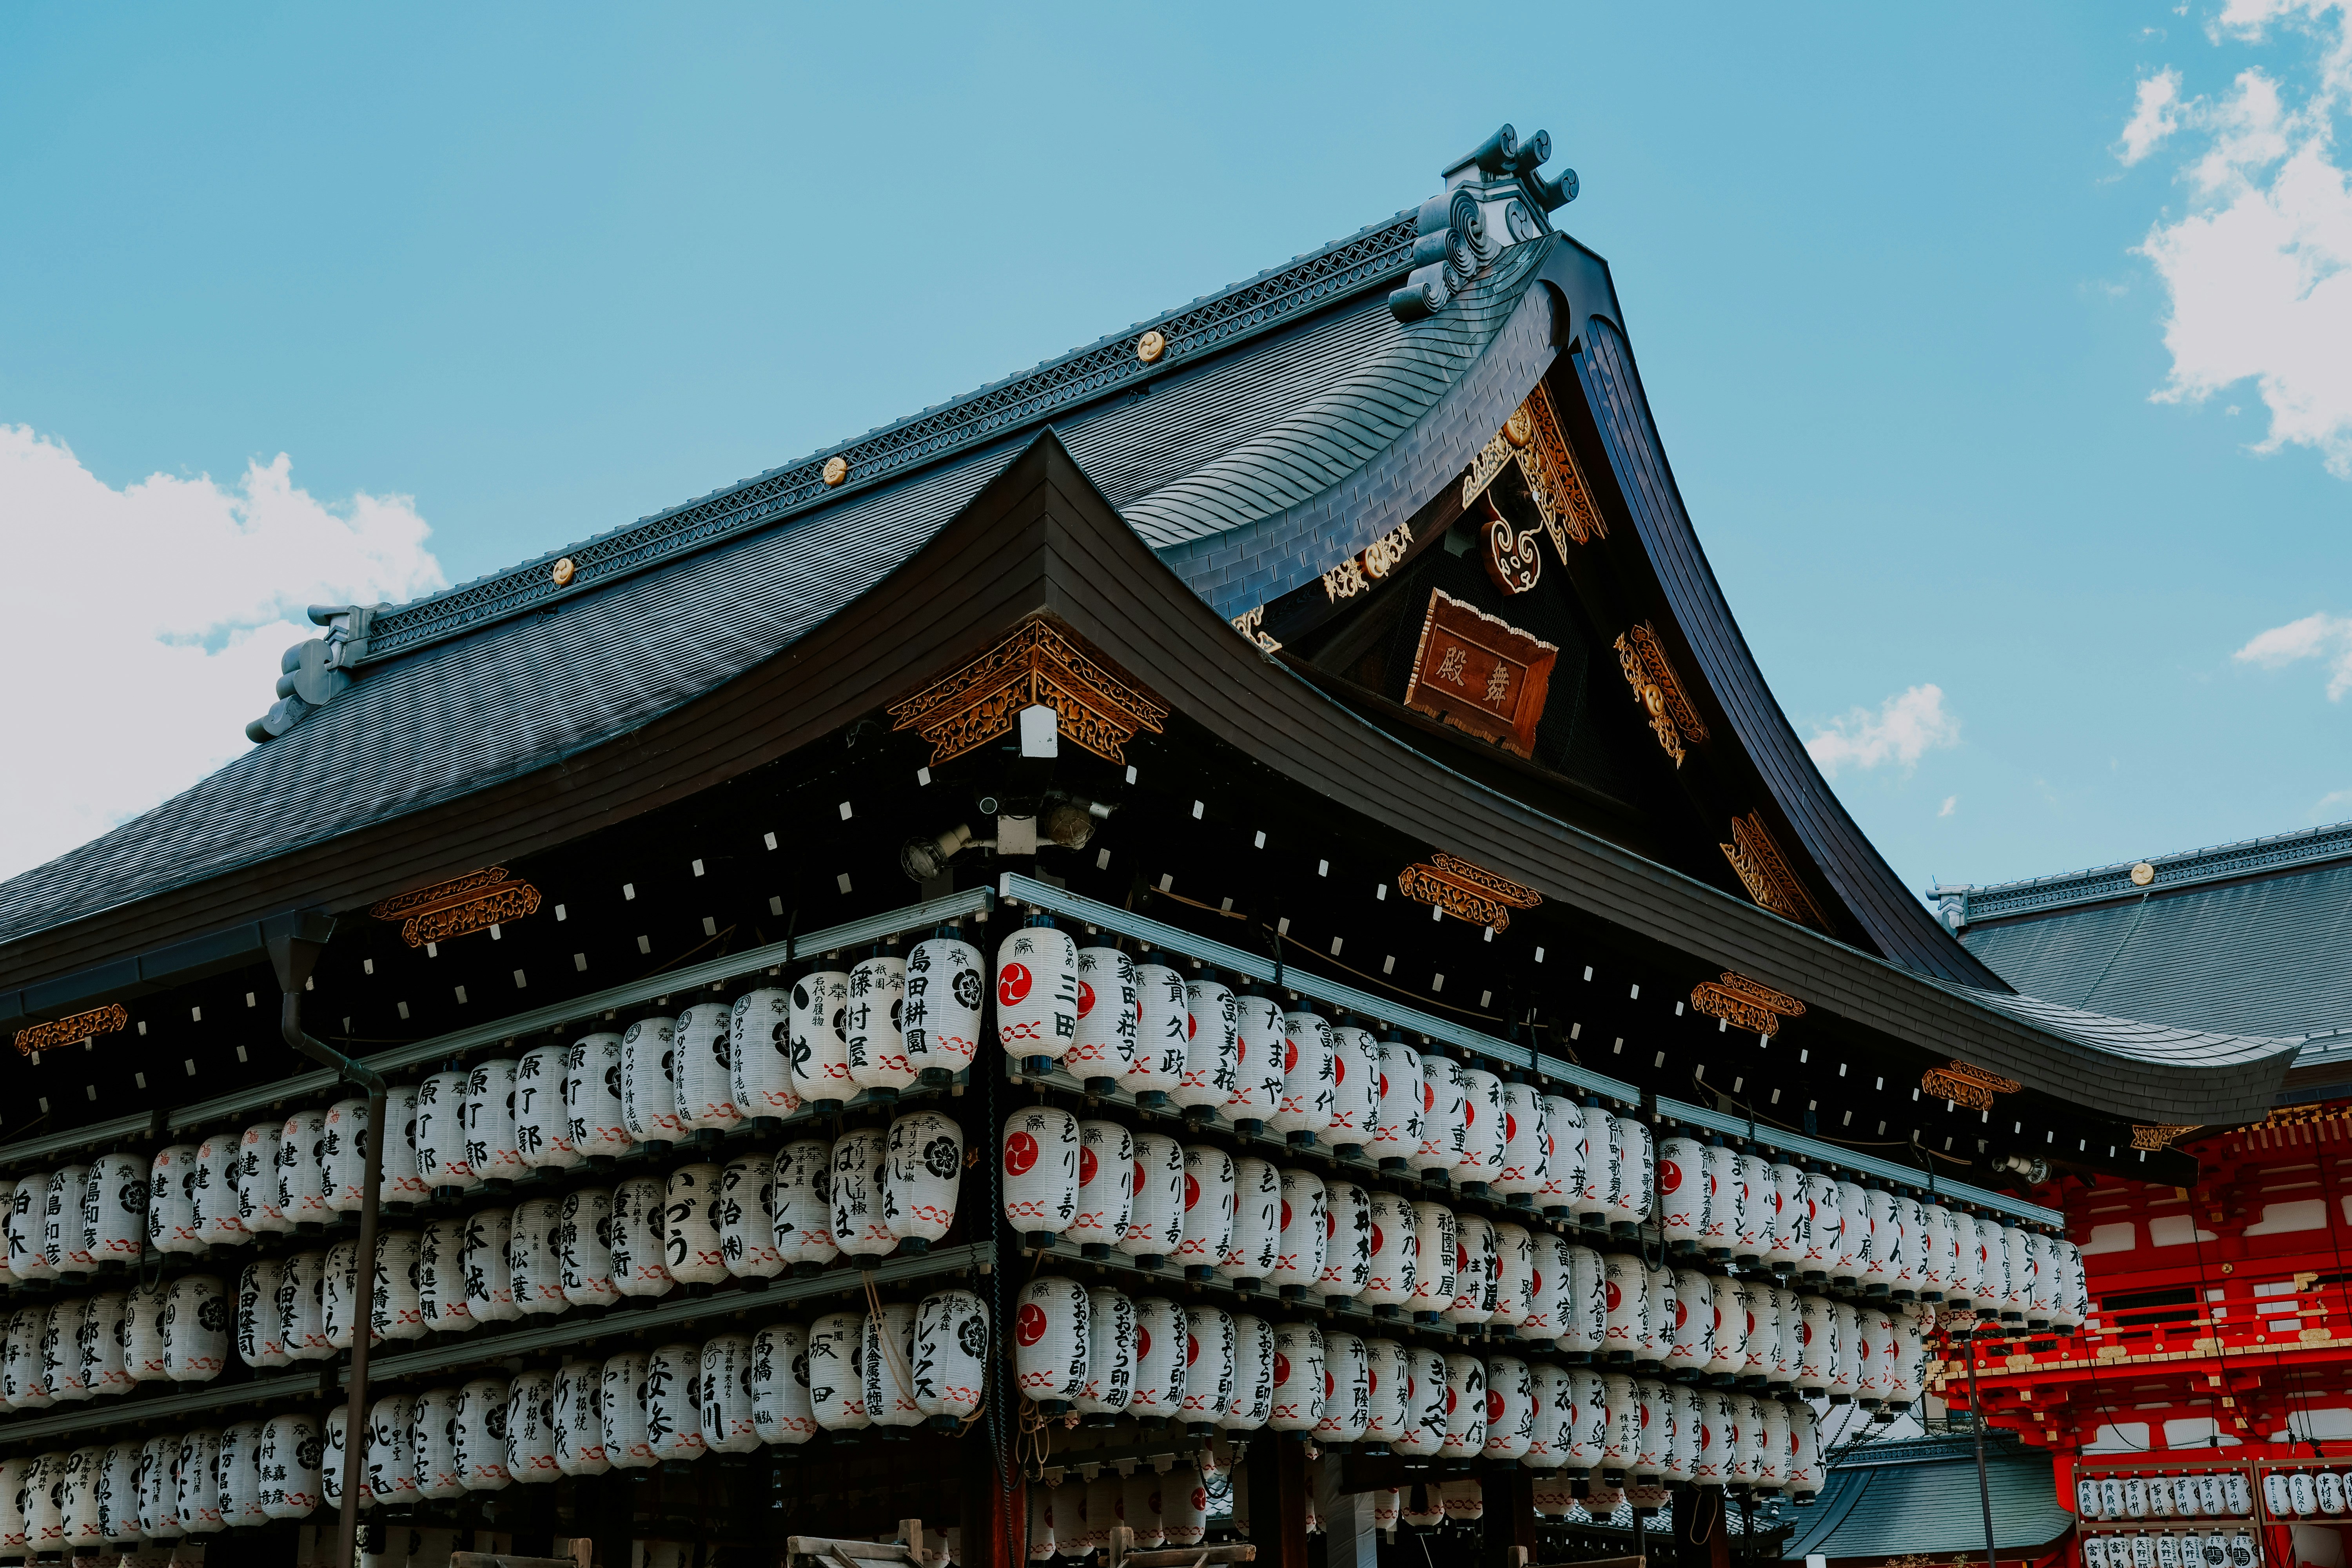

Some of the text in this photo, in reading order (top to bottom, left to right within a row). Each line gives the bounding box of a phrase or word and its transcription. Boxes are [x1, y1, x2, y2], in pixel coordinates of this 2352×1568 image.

[886, 972, 906, 991] 奉
[947, 948, 969, 967] 奉
[715, 1012, 731, 1030] 奉
[771, 998, 789, 1016] 奉
[812, 976, 825, 1026] 名代の履物
[828, 983, 847, 1001] 奉
[848, 966, 873, 1070] 藤村屋
[903, 945, 931, 1056] 島田耕園
[1054, 974, 1076, 1040] 三田
[1116, 955, 1136, 1062] 家田荘子
[602, 1041, 621, 1057] 奉
[657, 1027, 674, 1044] 奉
[1160, 972, 1185, 1079] 貴久政
[1260, 1004, 1284, 1105] たまや
[417, 1079, 440, 1175] 原了郭
[465, 1068, 488, 1169] 原了郭
[517, 1054, 543, 1155] 原了郭
[567, 1043, 587, 1147] 原了郭
[920, 1116, 944, 1132] 奉
[115, 1164, 136, 1181] 奉
[278, 1142, 298, 1208] 鍵善
[321, 1129, 341, 1198] 鍵善
[753, 1162, 773, 1177] 奉
[805, 1146, 824, 1162] 奉
[850, 1135, 868, 1215] チリメン山椒
[870, 1137, 886, 1154] 奉
[884, 1124, 904, 1219] はれま
[902, 1120, 920, 1183] チリメン山椒
[83, 1160, 105, 1250] 松島和彦
[149, 1173, 169, 1238] 鍵善
[192, 1164, 210, 1230] 鍵善
[238, 1151, 260, 1218] 鍵善
[542, 1203, 560, 1219] 奉
[592, 1195, 609, 1210] 奉
[641, 1184, 659, 1199] 奉
[706, 1179, 722, 1197] 奉
[774, 1151, 794, 1248] カトレア
[831, 1141, 855, 1238] はれま
[8, 1189, 32, 1259] 柏木
[44, 1172, 66, 1266] 松島和彦
[611, 1188, 632, 1279] 重兵衛
[666, 1173, 696, 1267] いづう
[194, 1283, 209, 1297] 奉
[280, 1258, 303, 1349] 武田隆久
[512, 1250, 534, 1303] 松葉
[951, 1297, 973, 1314] 奉
[1463, 1259, 1481, 1302] 住井
[239, 1265, 261, 1357] 武田隆司
[782, 1332, 798, 1347] 奉
[938, 1295, 954, 1332] 株式会社
[681, 1351, 698, 1366] 奉
[810, 1334, 838, 1404] 坂田
[914, 1297, 941, 1399] アレックス
[481, 1387, 497, 1401] 奉
[603, 1366, 621, 1454] わたなべ
[703, 1374, 723, 1440] 吉川
[1349, 1339, 1368, 1428] 井上隆保
[261, 1423, 277, 1459] 志村
[292, 1424, 312, 1437] 奉
[1619, 1413, 1629, 1453] 株式会社
